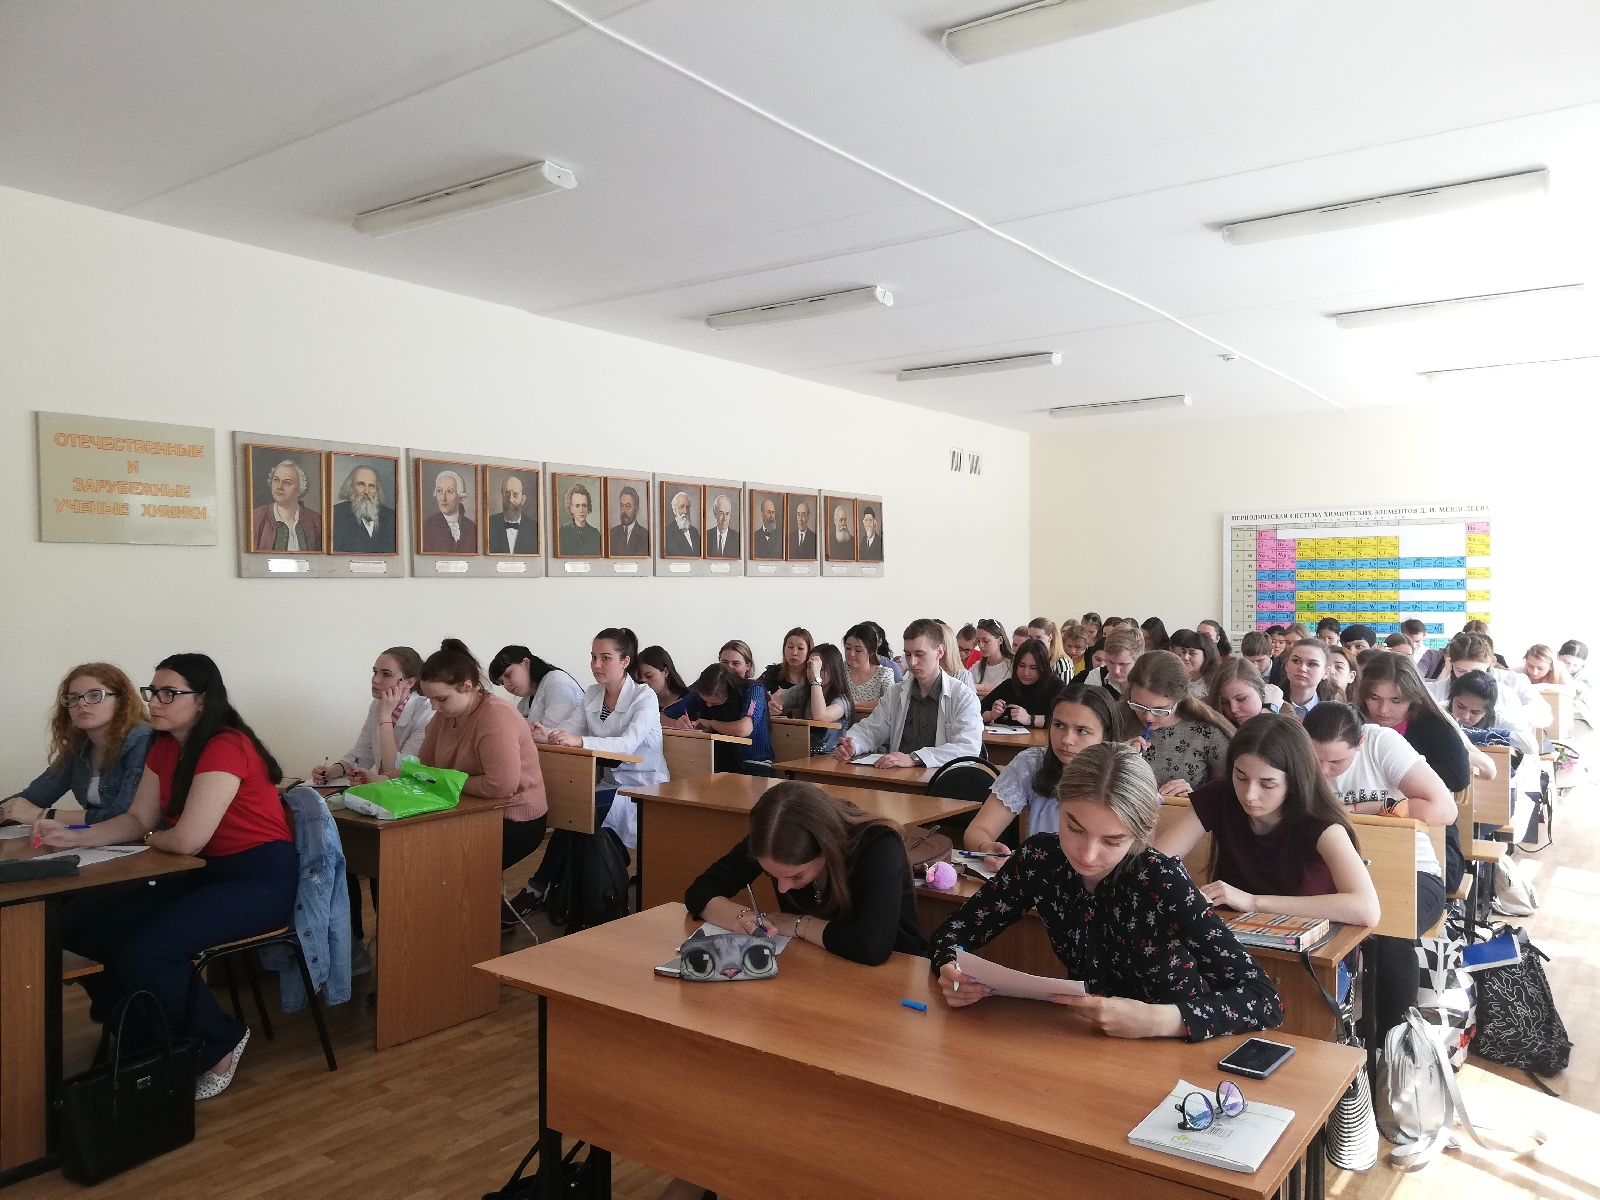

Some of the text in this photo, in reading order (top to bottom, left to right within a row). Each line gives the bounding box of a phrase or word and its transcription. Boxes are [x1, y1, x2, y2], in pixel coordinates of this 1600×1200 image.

[54, 432, 204, 458] ОТЕЧЕСТВЕННЫЕ
[127, 460, 139, 474] И
[72, 478, 191, 498] ЗАРУБЕЖНЫЕ
[54, 498, 207, 519] УЧЕНЫЕ ХИМИКИ
[1231, 513, 1288, 521] ПЕРИОДИЧЕСКАЯ
[1289, 511, 1322, 519] СИСТЕМА
[1323, 509, 1373, 518] ХИМИЧЕСКИХ
[1439, 505, 1490, 513] МЕНДЕЛЕЕВА
